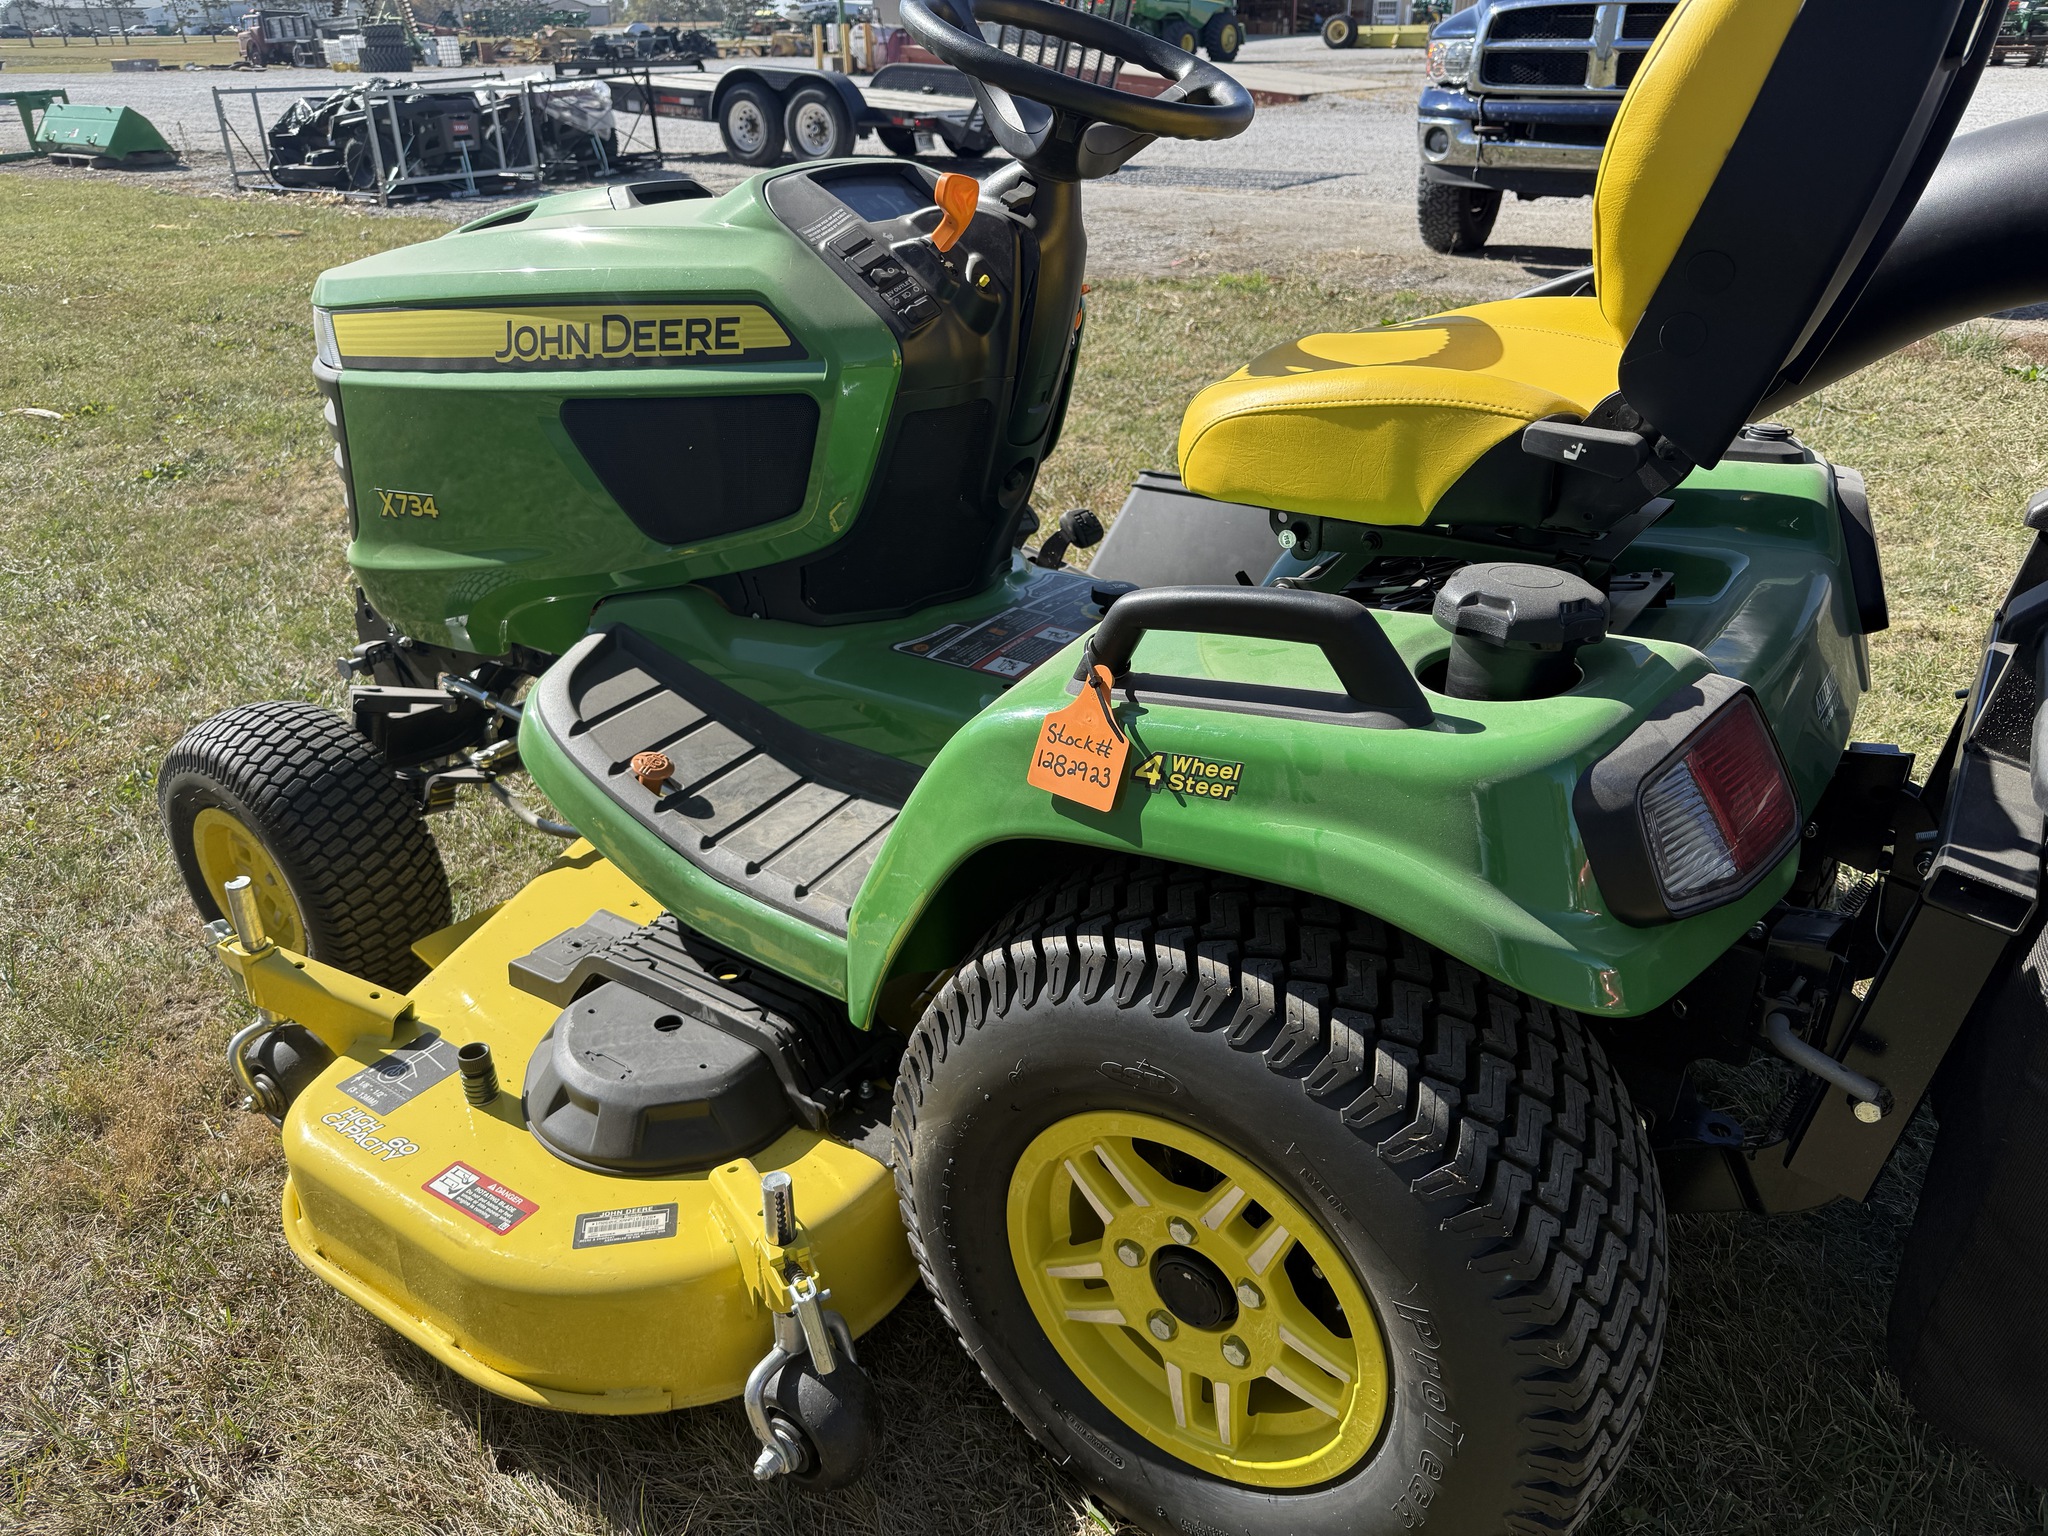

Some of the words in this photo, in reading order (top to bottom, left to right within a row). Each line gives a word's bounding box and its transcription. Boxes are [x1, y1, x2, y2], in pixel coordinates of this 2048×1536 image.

[893, 279, 912, 293] OUTLET
[495, 319, 592, 360] JOHN
[601, 313, 743, 356] DEERE
[378, 491, 439, 518] X734
[1037, 749, 1111, 788] 1282923
[1134, 753, 1165, 786] 4
[1172, 754, 1242, 781] Wheel
[1168, 773, 1235, 798] Steer
[321, 1112, 403, 1162] CAPACITY
[340, 1106, 385, 1134] HIGH
[388, 1137, 420, 1156] 60
[474, 1186, 500, 1204] ROTATING
[498, 1200, 517, 1214] BLADE
[495, 1186, 524, 1205] DANGER
[1299, 1168, 1347, 1214] NYLON
[600, 1210, 623, 1218] JOHN
[625, 1206, 654, 1214] DEERE
[1391, 1300, 1465, 1529] ProTech
